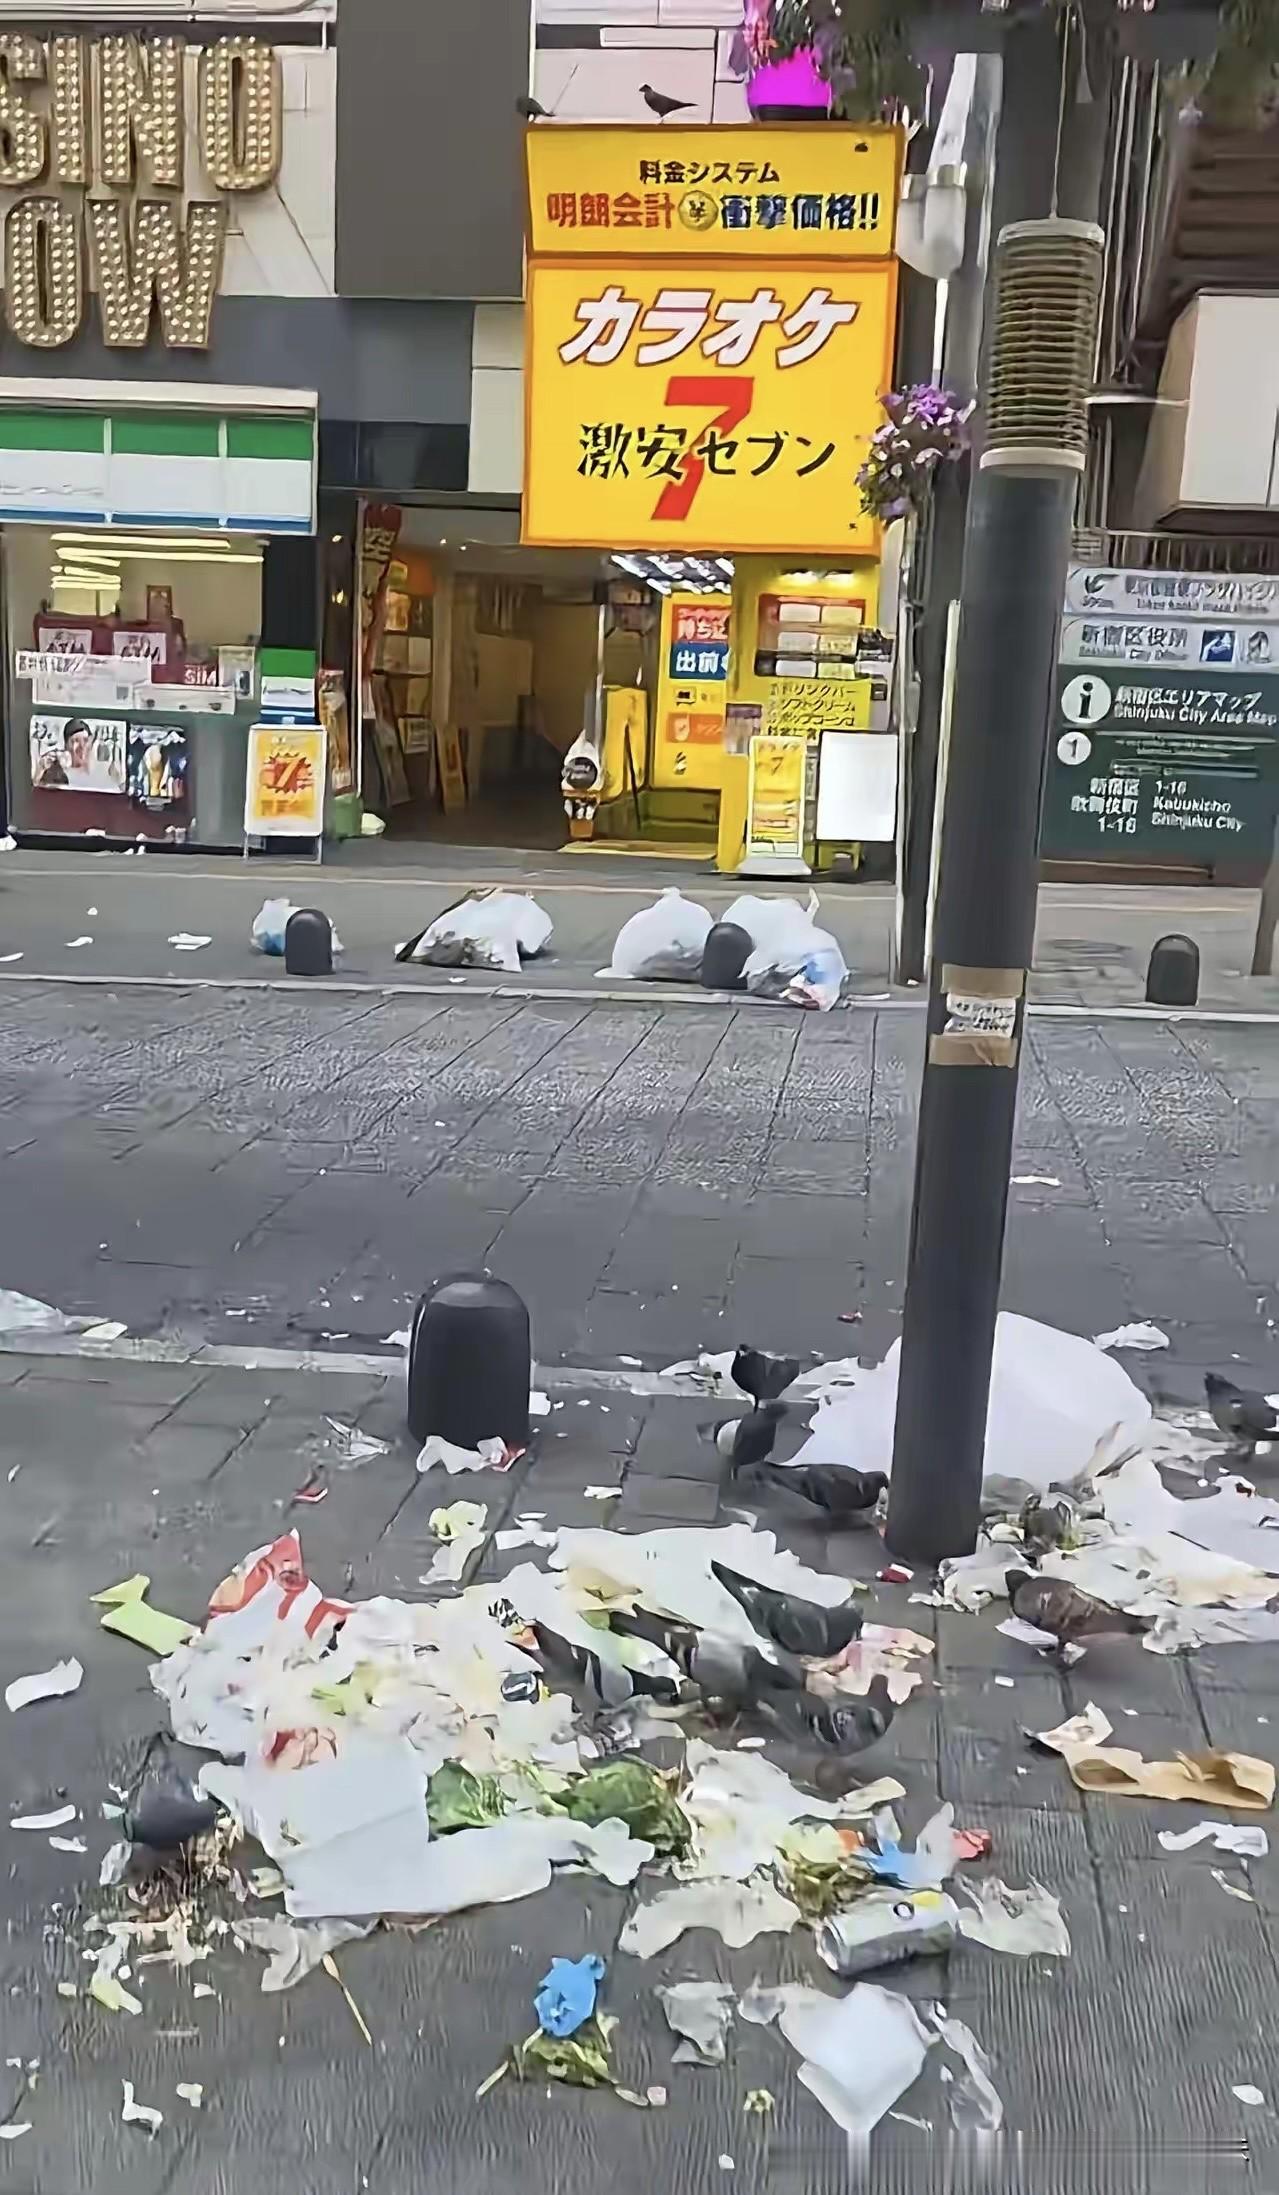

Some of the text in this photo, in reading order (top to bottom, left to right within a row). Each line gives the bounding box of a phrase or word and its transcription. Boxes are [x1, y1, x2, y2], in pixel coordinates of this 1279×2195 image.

[639, 160, 780, 184] 料金システム
[547, 192, 675, 229] 明朗会計
[5, 197, 229, 347] OW
[558, 286, 860, 369] カラオケ
[577, 423, 836, 481] 激安セブン
[650, 376, 755, 521] 7
